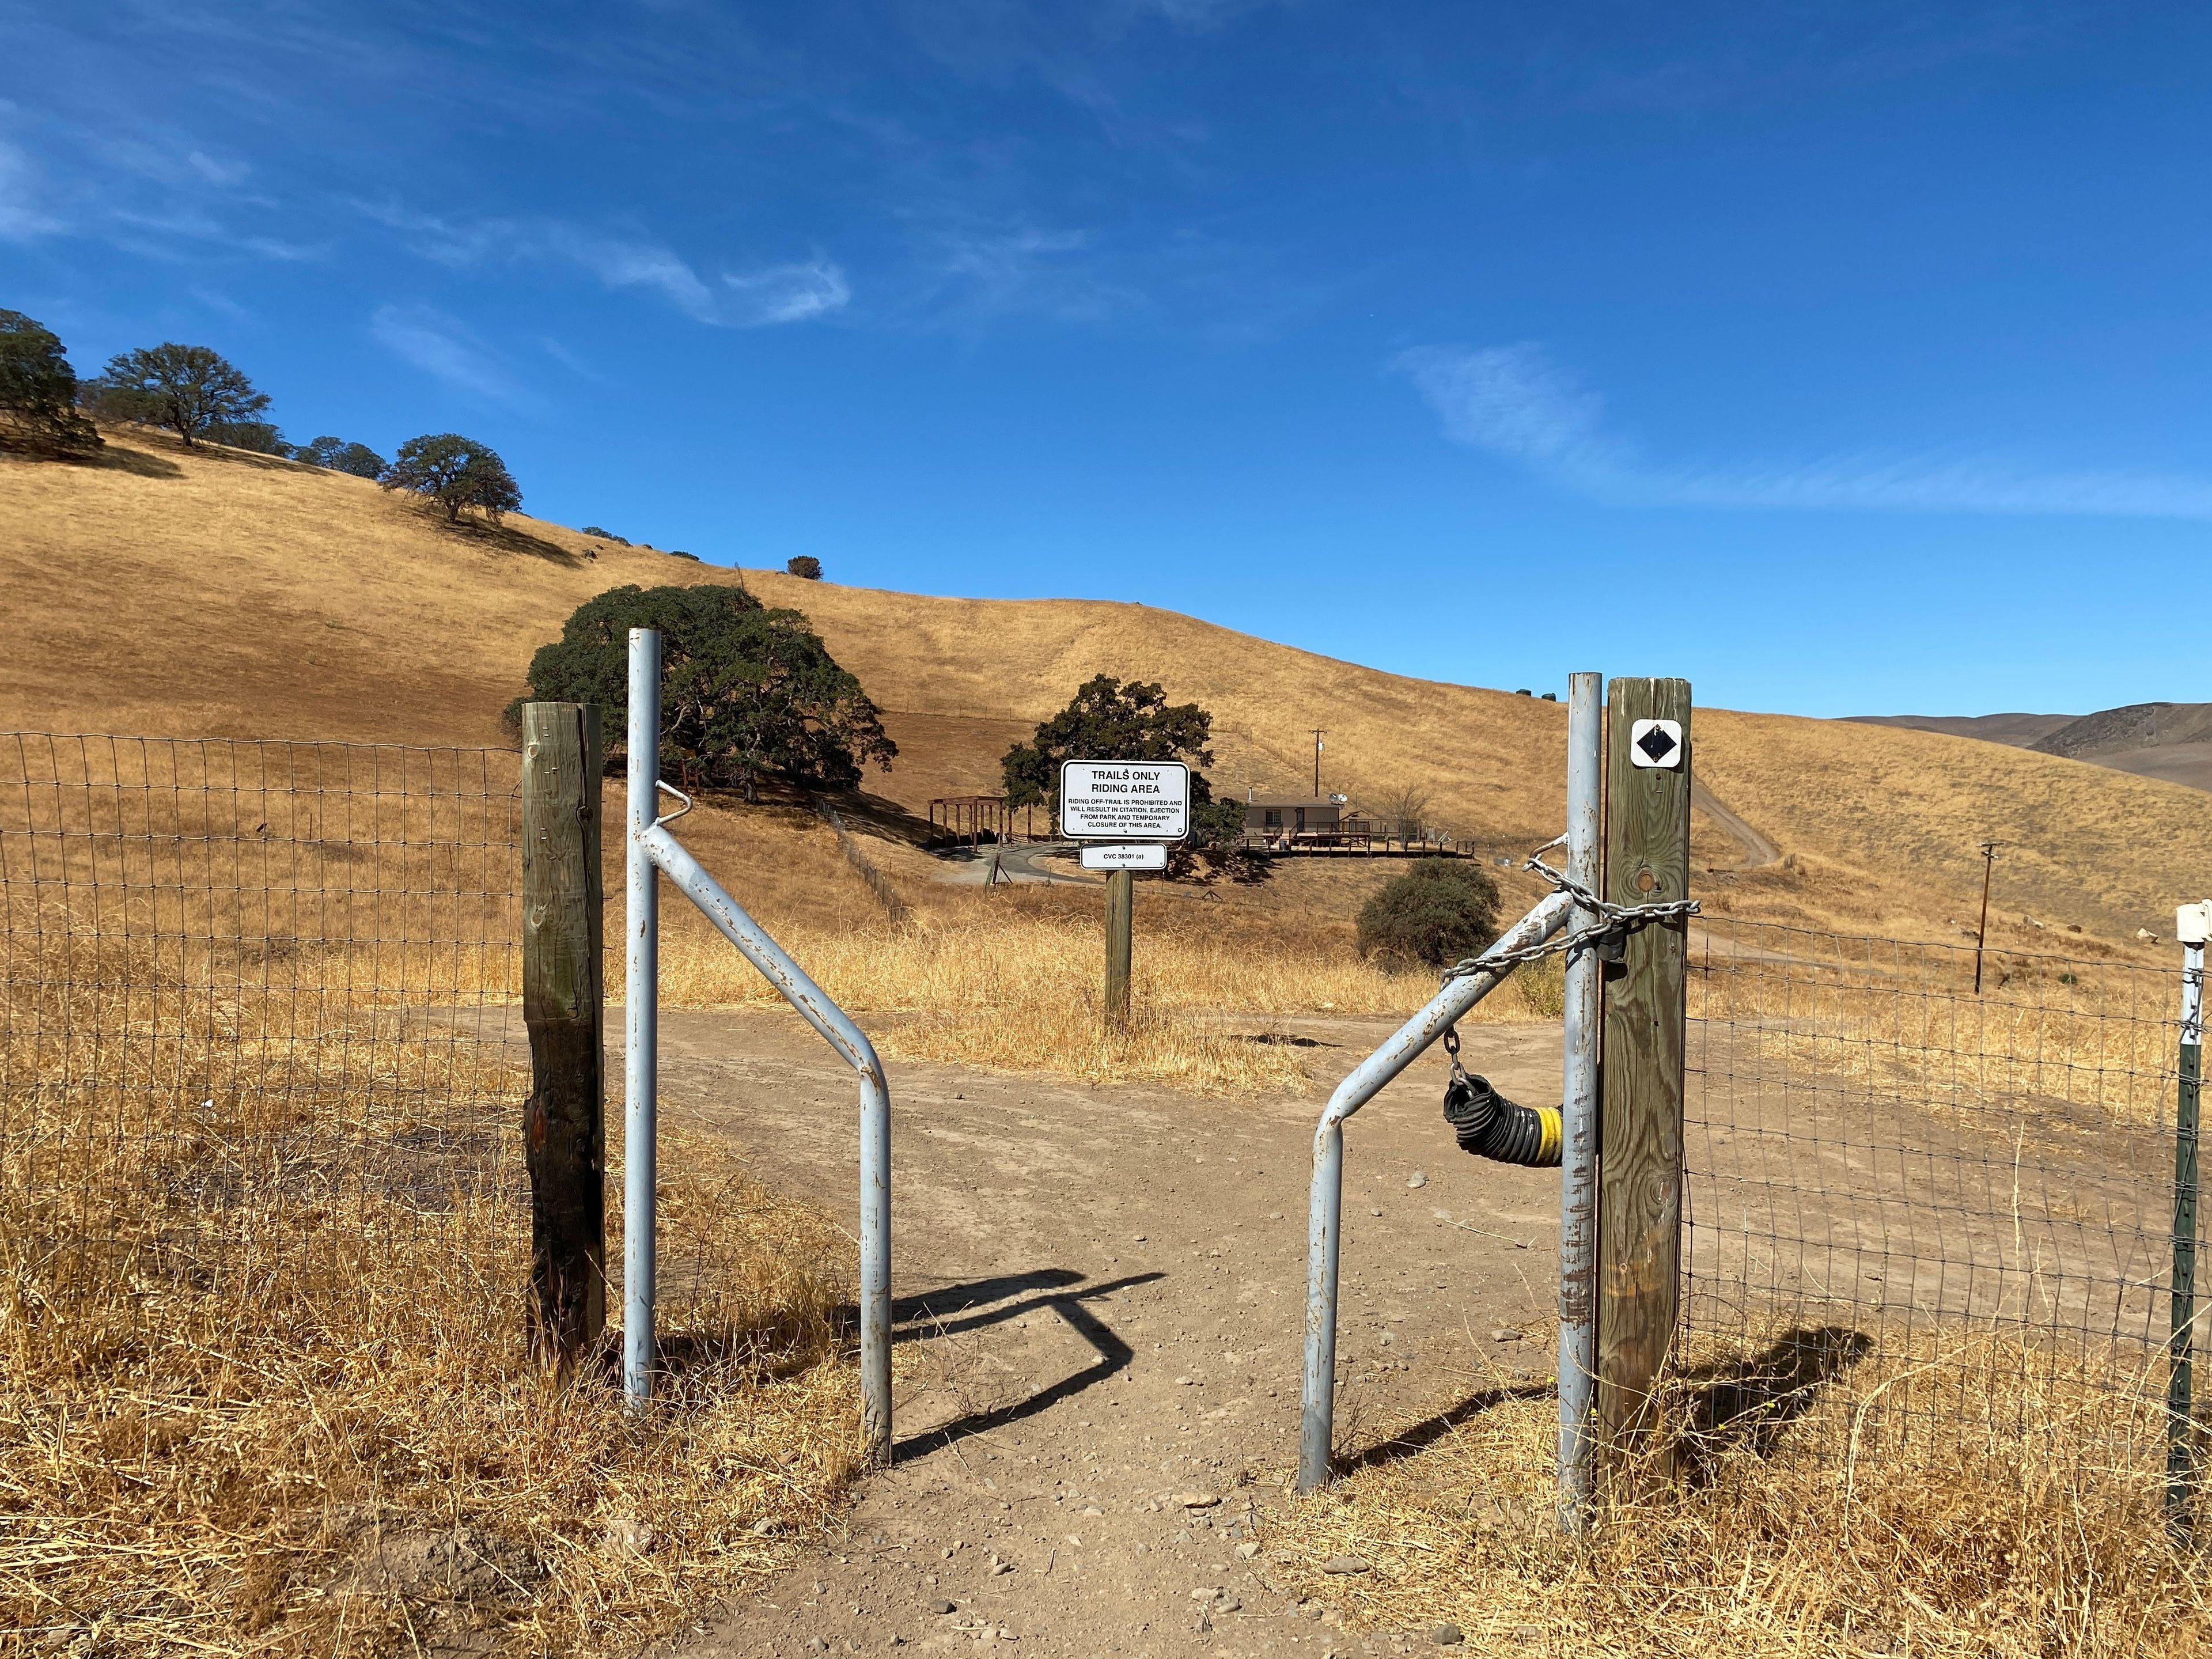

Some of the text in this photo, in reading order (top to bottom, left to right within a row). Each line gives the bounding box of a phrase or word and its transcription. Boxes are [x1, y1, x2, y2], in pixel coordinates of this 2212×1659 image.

[1092, 771, 1160, 780] TRAILS ONLY
[1092, 784, 1160, 793] RIDING AREA
